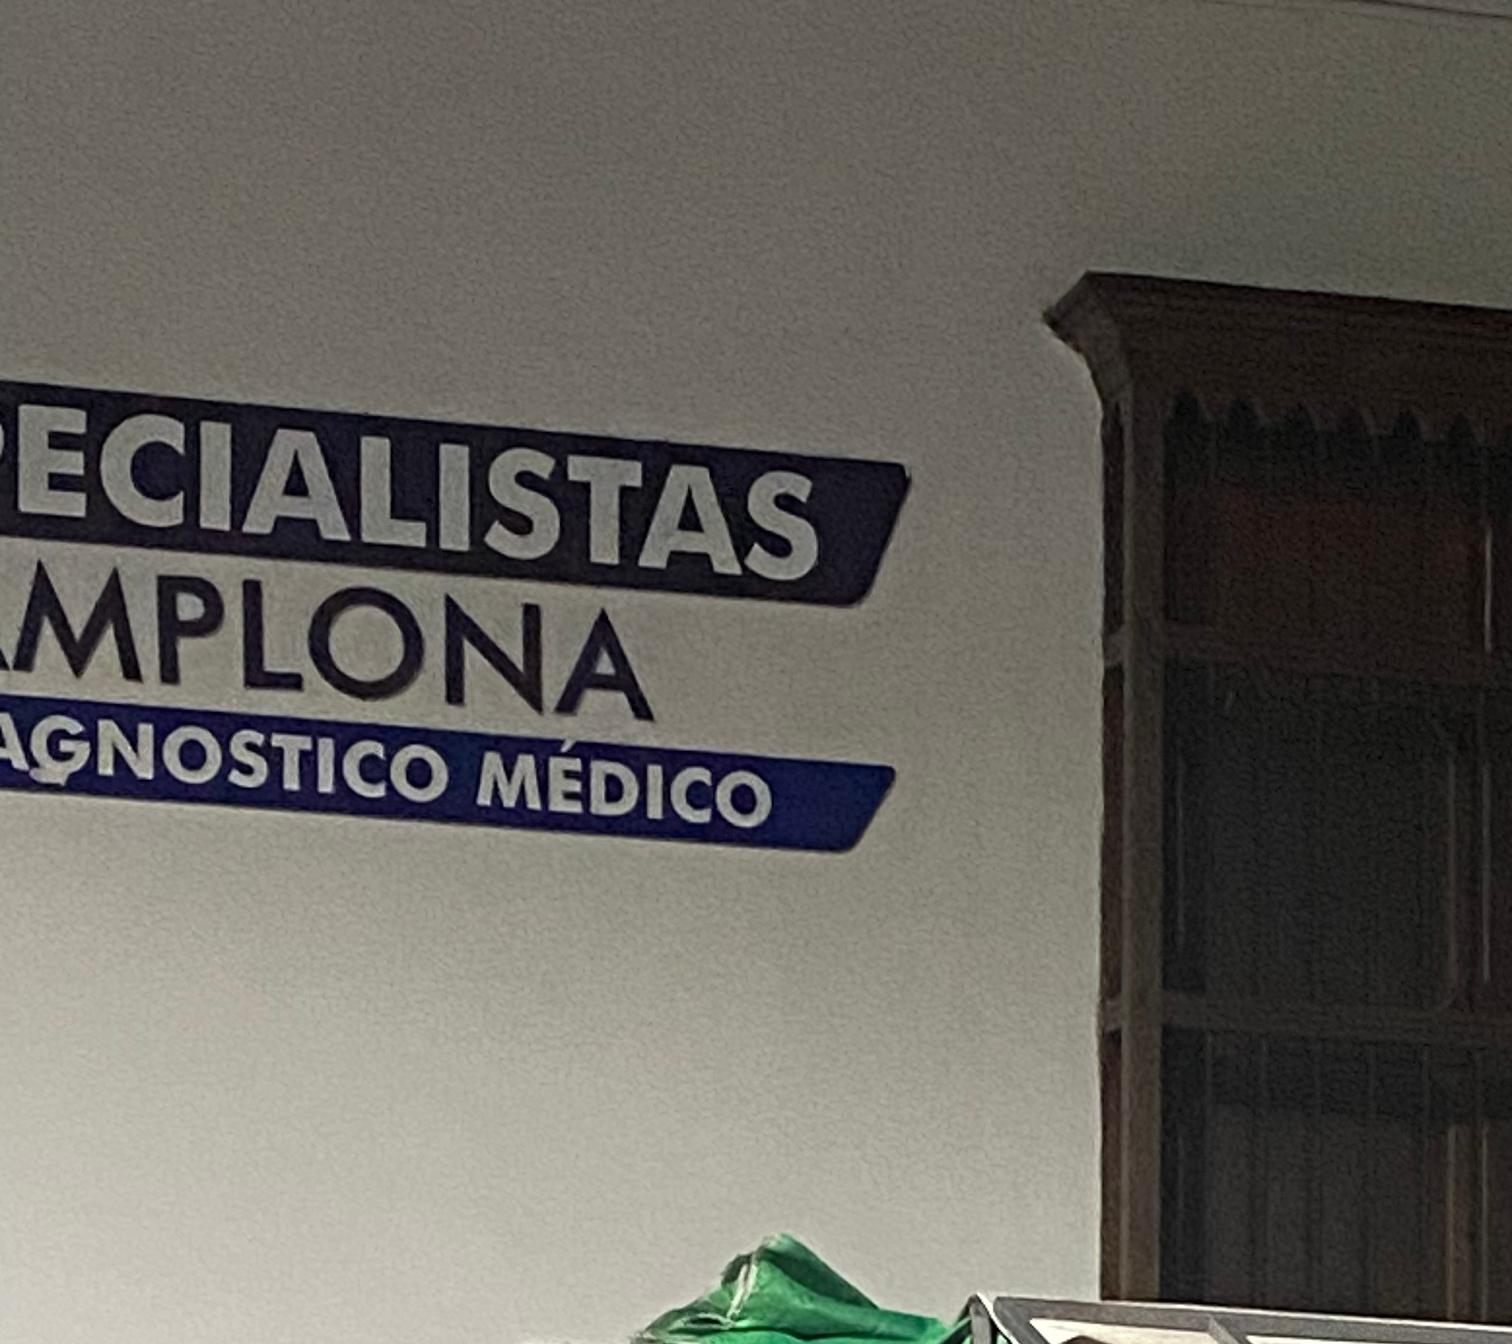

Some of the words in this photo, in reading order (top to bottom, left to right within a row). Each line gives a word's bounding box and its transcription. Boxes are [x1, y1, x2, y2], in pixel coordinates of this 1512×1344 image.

[0, 403, 820, 581] ECIALISTAS
[0, 560, 656, 723] MPLONA
[476, 737, 773, 829] MÉDICO
